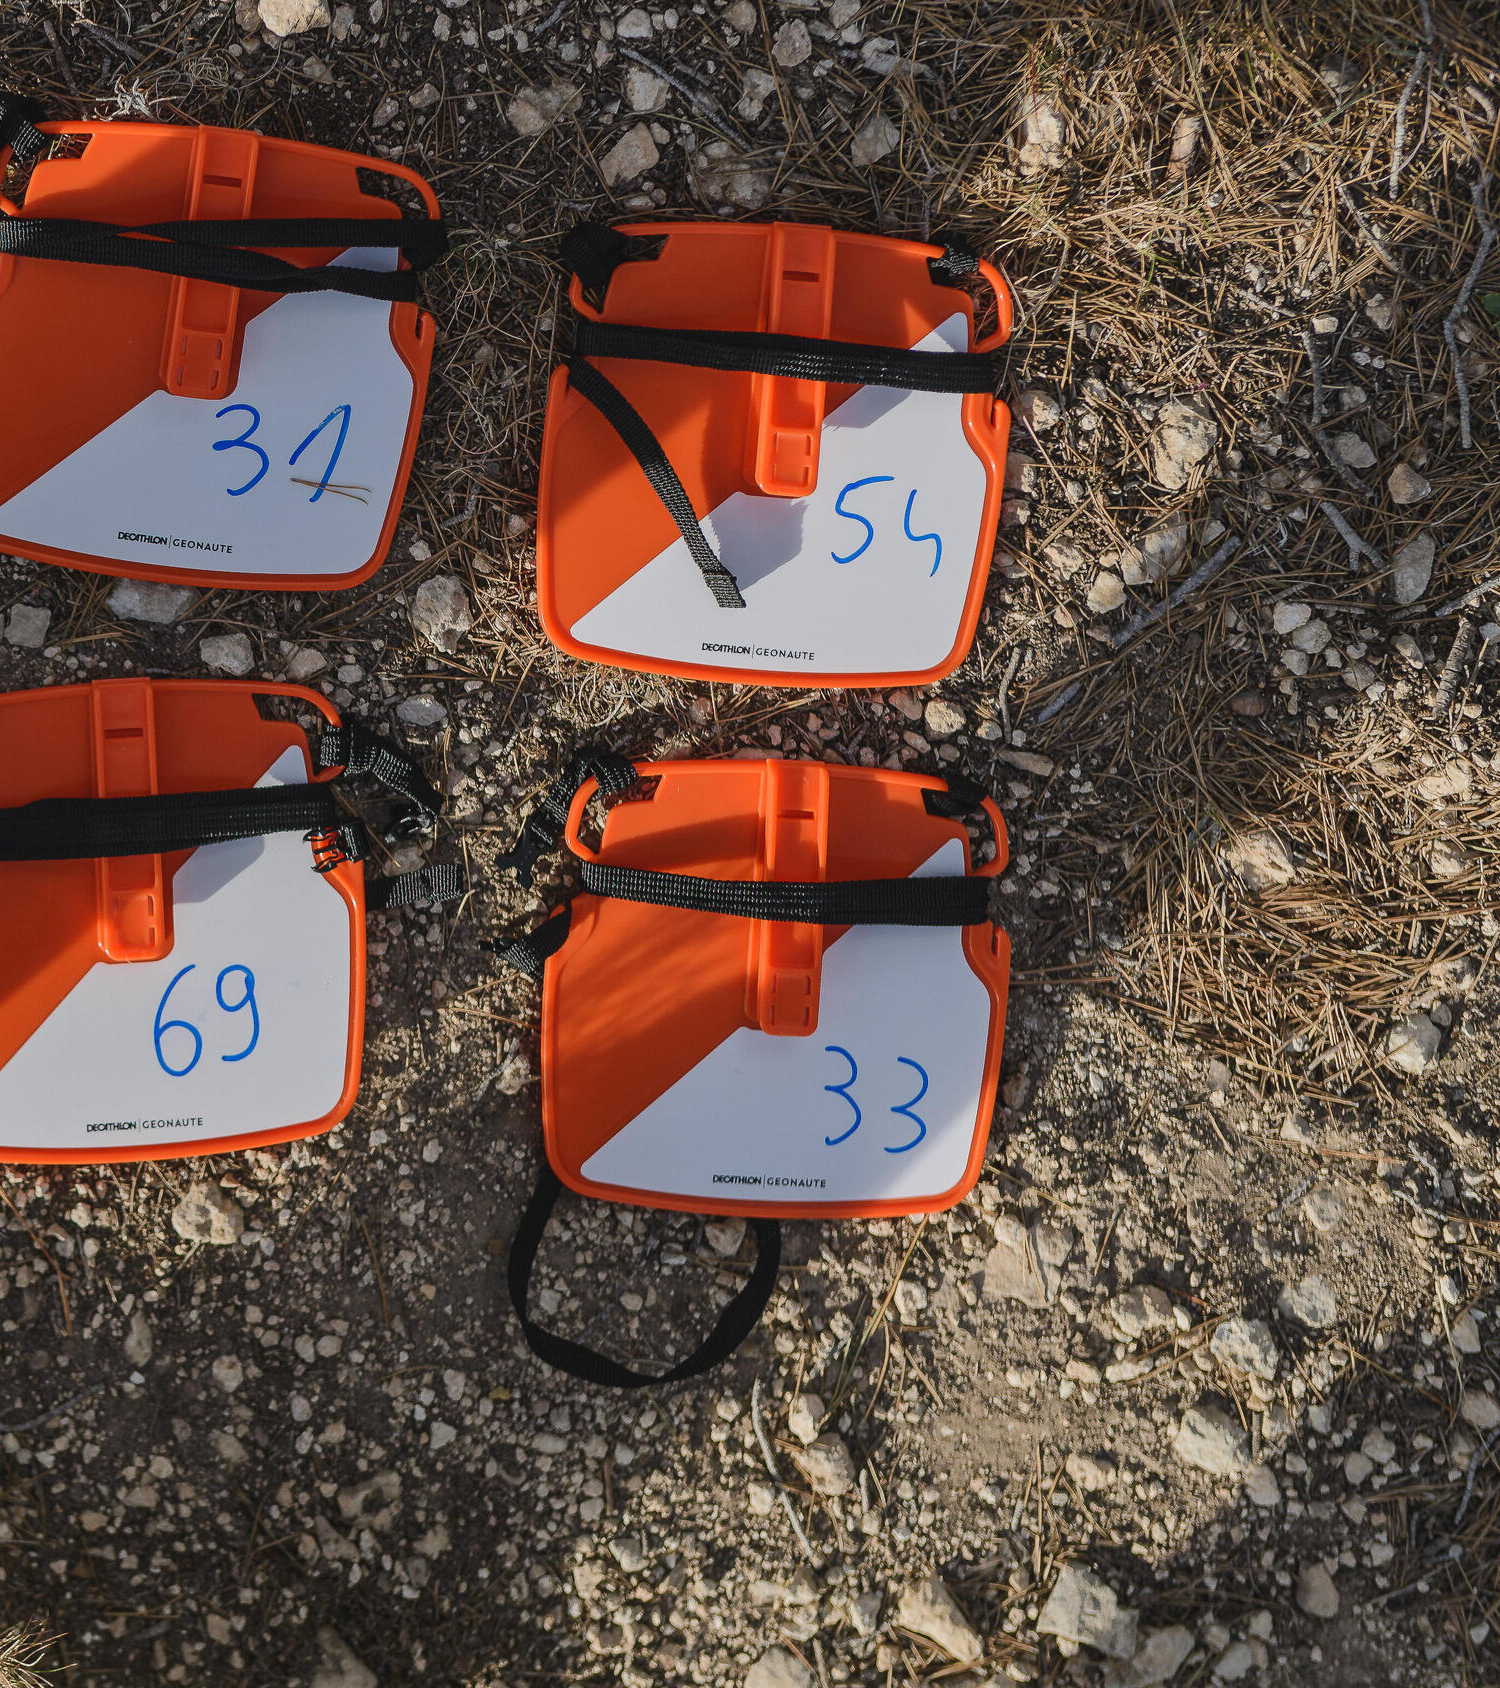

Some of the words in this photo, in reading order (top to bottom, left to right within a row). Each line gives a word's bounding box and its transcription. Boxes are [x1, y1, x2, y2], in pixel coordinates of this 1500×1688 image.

[212, 403, 352, 502] 31
[117, 531, 168, 546] DECATHLON
[172, 538, 233, 554] GEONAUTE
[831, 475, 942, 577] 54
[701, 642, 751, 655] DECATHLON
[755, 647, 816, 661] GEONAUTE
[154, 963, 260, 1077] 69
[86, 1121, 137, 1133] DECATHLON
[142, 1117, 203, 1129] GEONAUTE
[824, 1045, 929, 1153] 33
[712, 1174, 762, 1185] DECATHLON
[766, 1176, 827, 1188] GEONAUTE
